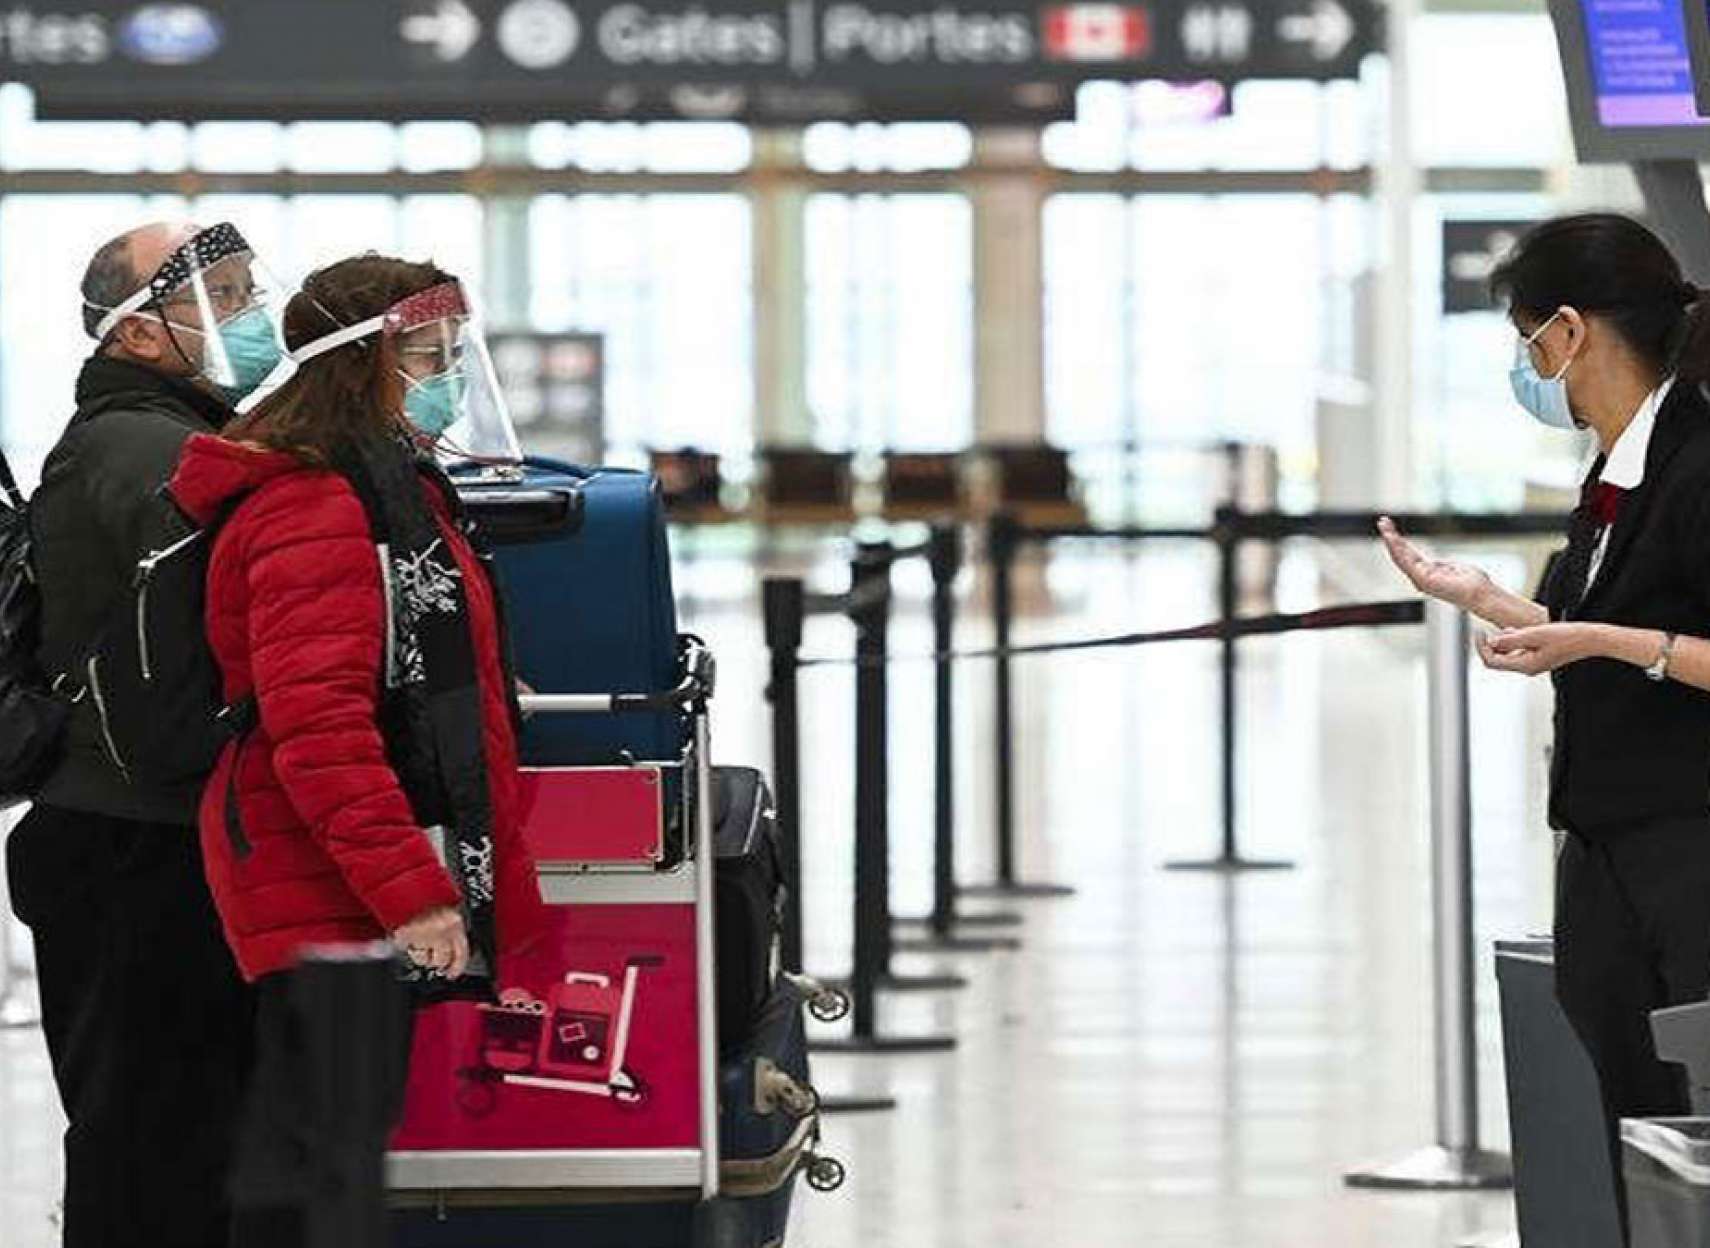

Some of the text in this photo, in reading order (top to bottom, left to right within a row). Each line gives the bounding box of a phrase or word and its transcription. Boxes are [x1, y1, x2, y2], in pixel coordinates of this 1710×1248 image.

[0, 10, 107, 63] tes
[599, 4, 1033, 63] Gates Portes
